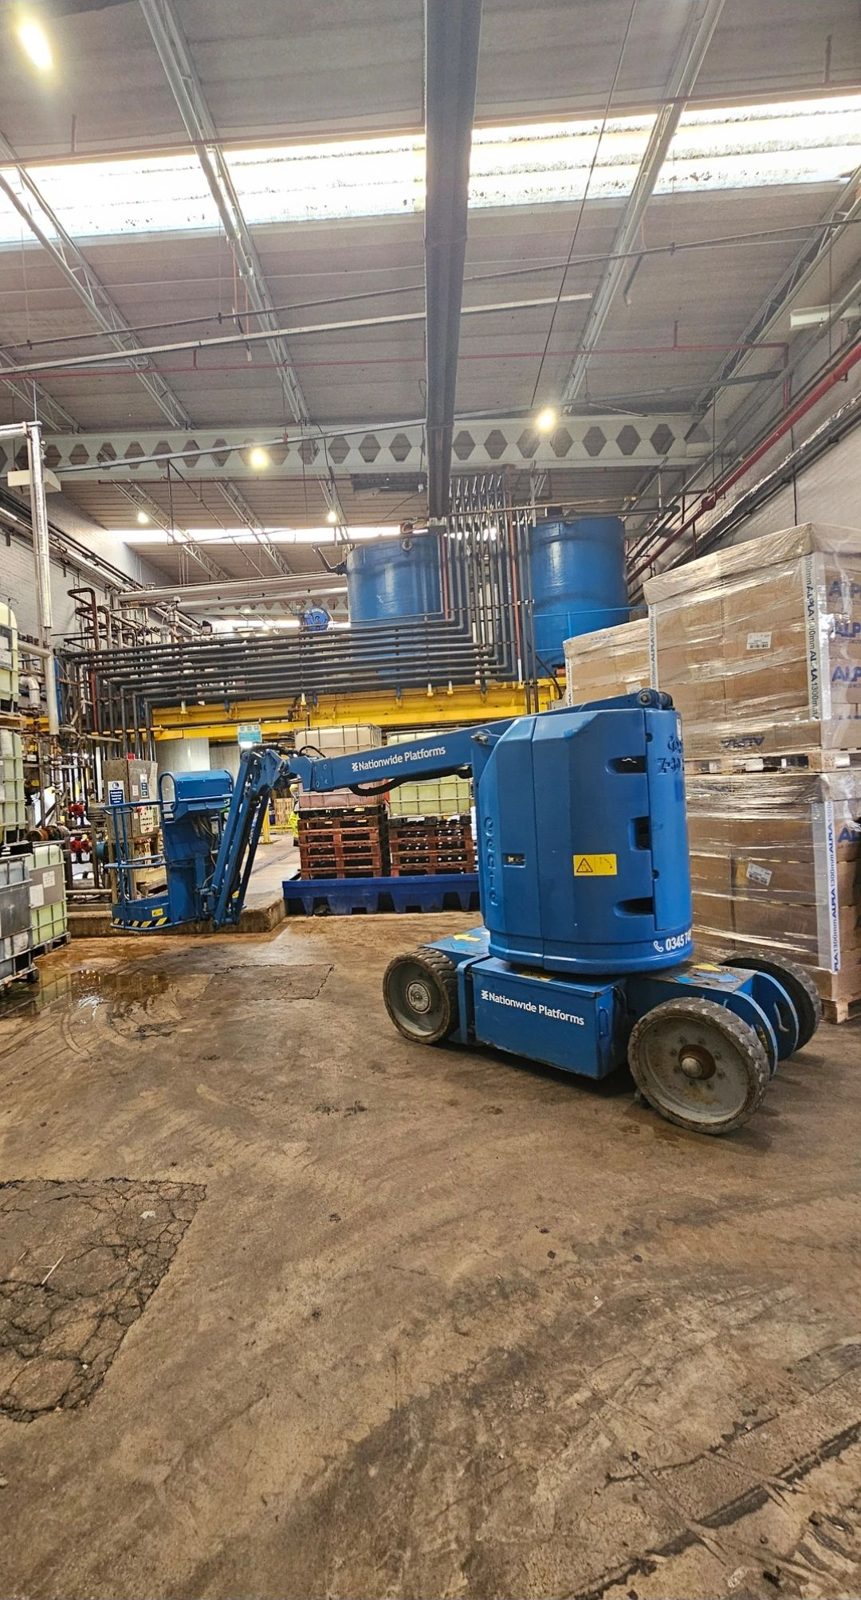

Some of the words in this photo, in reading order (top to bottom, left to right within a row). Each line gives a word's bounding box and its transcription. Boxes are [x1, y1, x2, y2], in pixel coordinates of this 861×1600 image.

[809, 651, 818, 682] ALLA
[358, 754, 403, 771] Nationwide
[404, 746, 446, 762] Platforms
[665, 934, 685, 951] 0345
[488, 992, 537, 1013] Nationwide
[538, 1004, 585, 1026] Platforms
